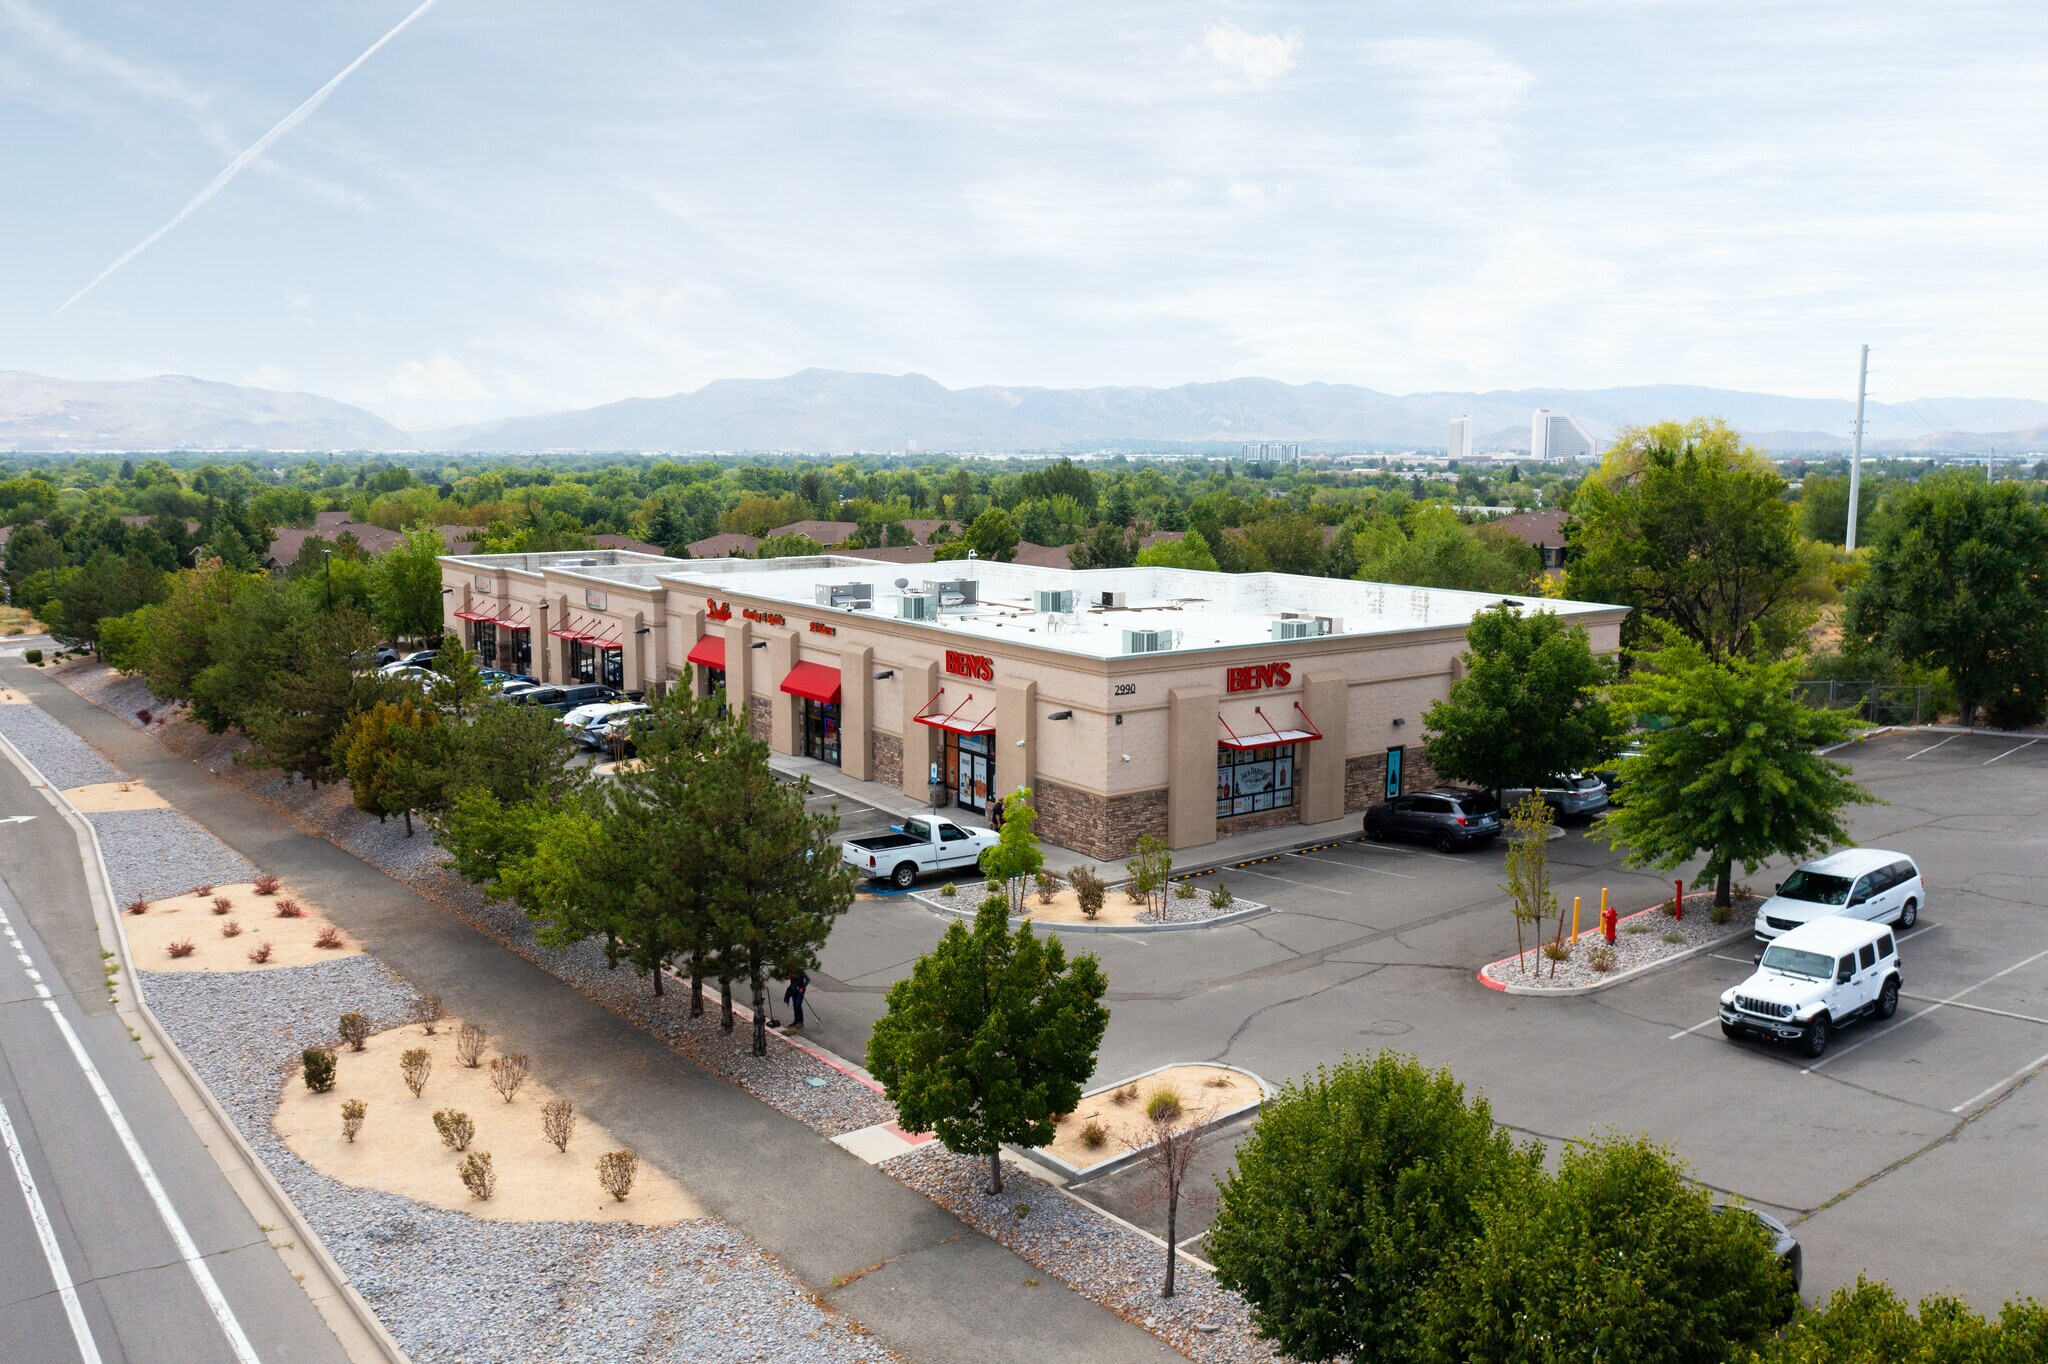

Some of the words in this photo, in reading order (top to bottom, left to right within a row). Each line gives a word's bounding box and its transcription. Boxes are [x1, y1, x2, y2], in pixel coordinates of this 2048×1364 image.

[946, 650, 994, 682] BEN'S
[1227, 662, 1291, 693] BEN'S
[1115, 683, 1136, 696] 2990
